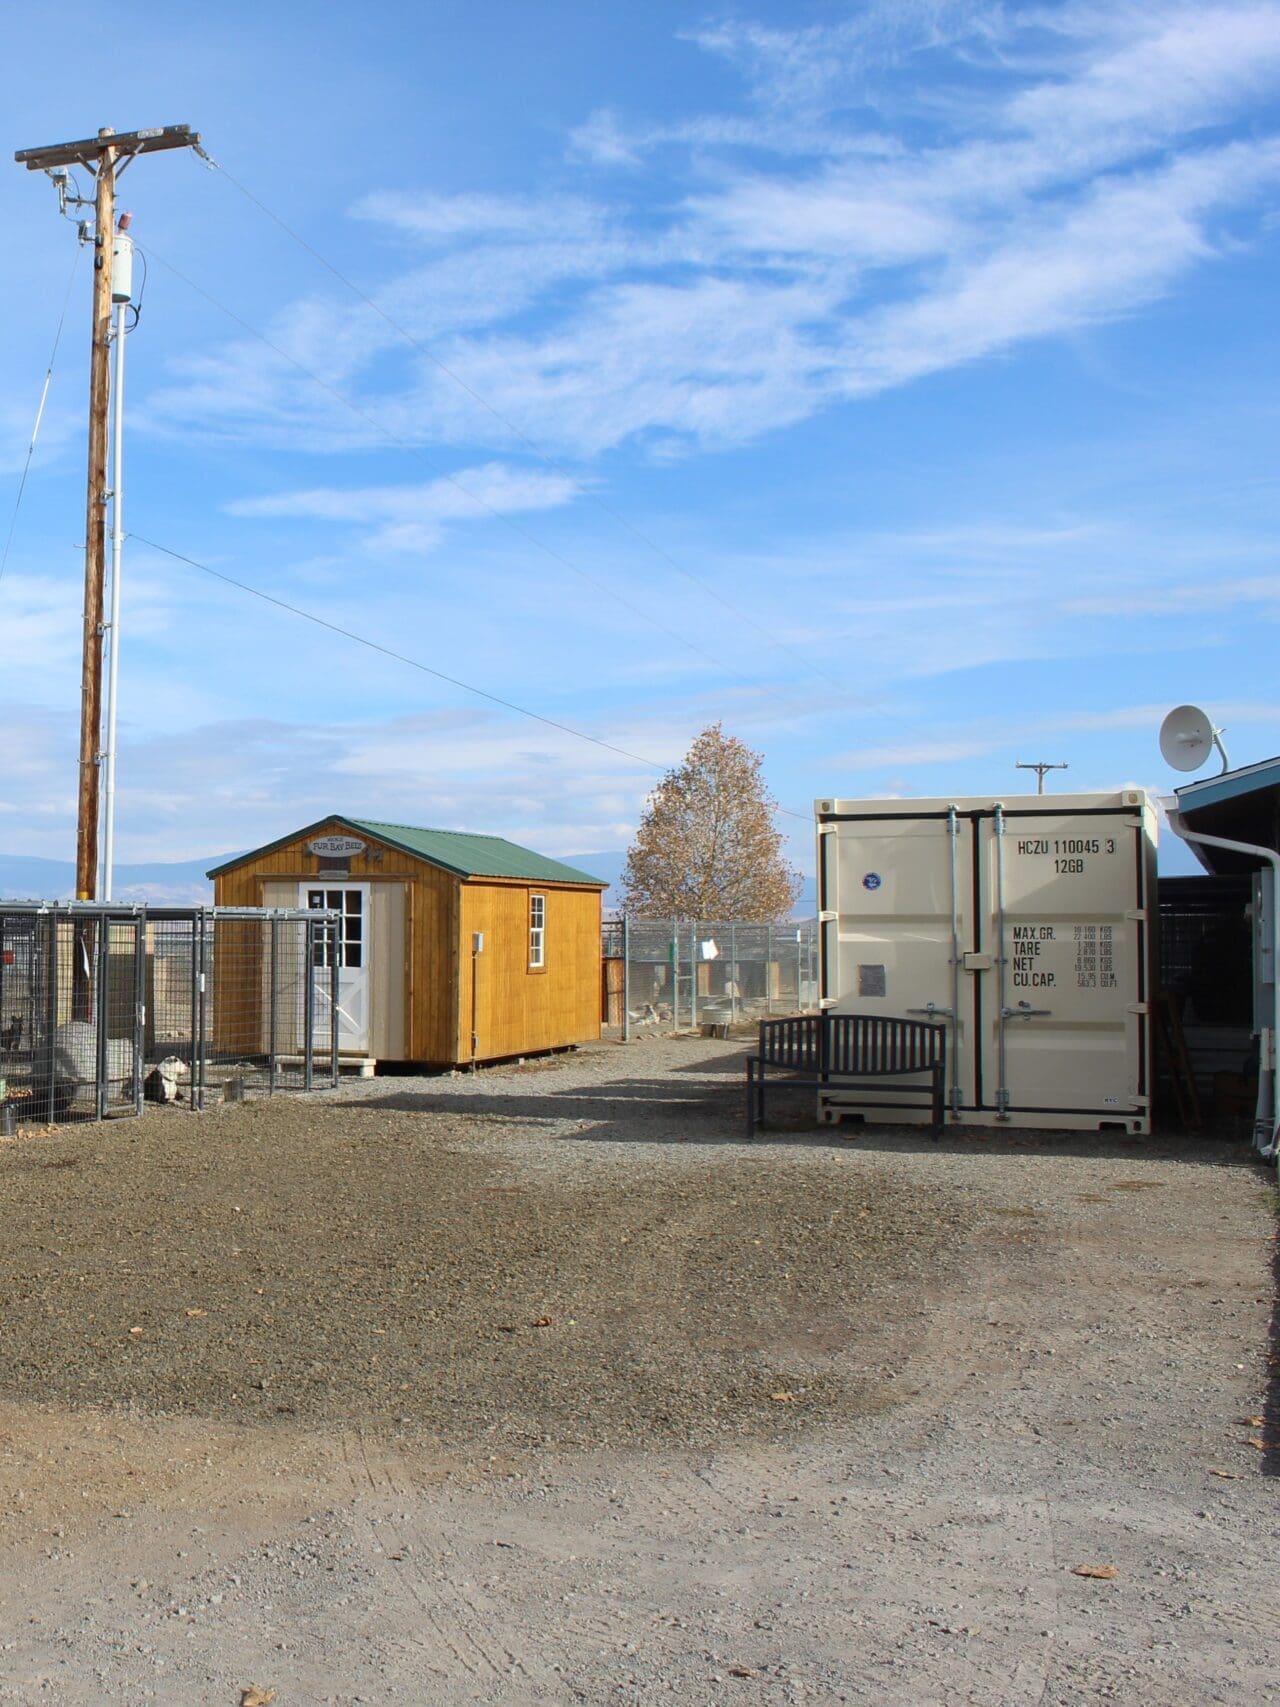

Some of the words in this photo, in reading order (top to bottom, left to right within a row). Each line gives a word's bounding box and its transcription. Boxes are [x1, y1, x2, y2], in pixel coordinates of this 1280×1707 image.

[313, 842, 328, 850] FUR
[1018, 840, 1049, 854] HCZU
[1054, 840, 1100, 854] 110045
[1106, 839, 1115, 854] 3
[1054, 859, 1084, 873] 12GB
[1013, 926, 1057, 940] MAX.GR.
[1013, 941, 1041, 955] TARE
[1013, 957, 1034, 971] NET
[1013, 973, 1057, 987] CU.CAP.
